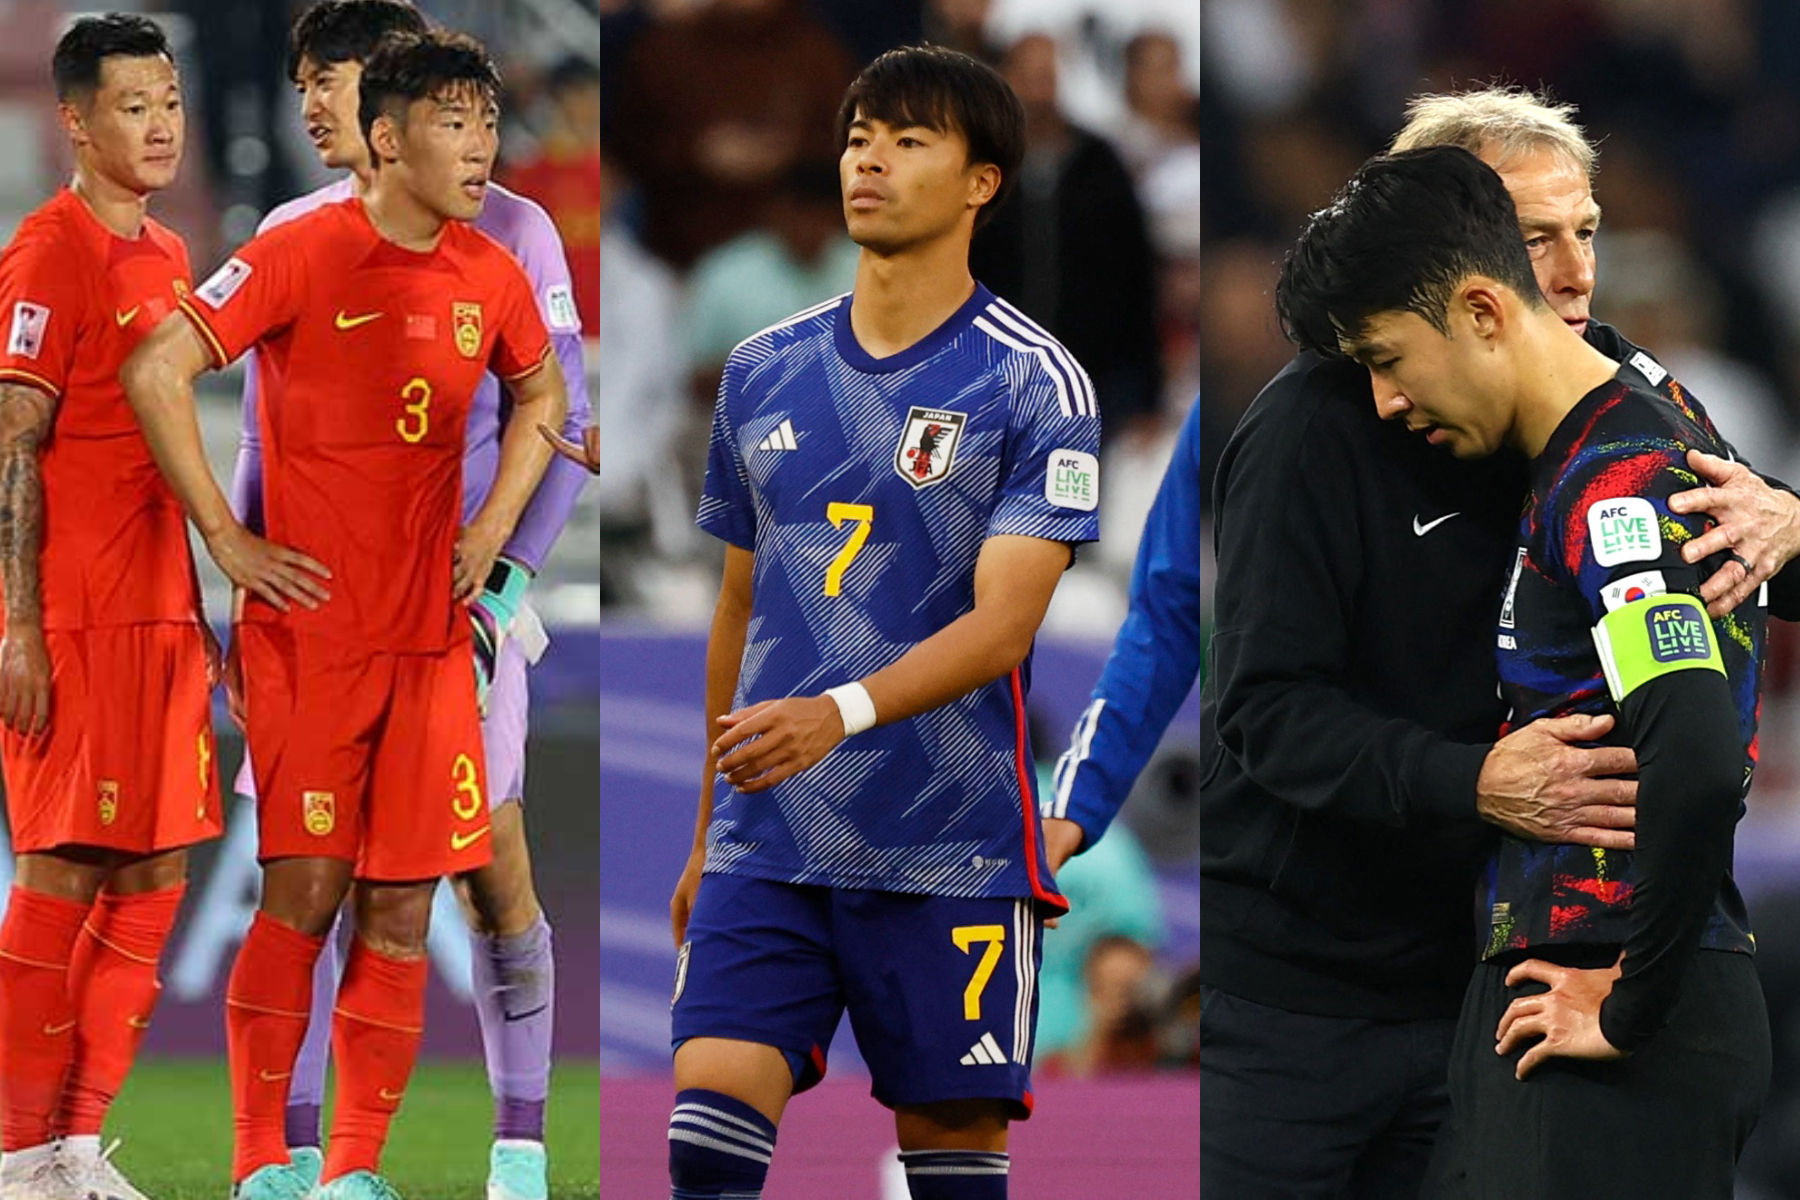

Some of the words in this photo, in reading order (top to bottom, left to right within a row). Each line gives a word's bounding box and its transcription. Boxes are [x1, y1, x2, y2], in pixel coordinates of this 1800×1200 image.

[397, 378, 431, 443] 3
[923, 411, 953, 422] JAPAN
[1057, 458, 1079, 470] AFC
[1056, 468, 1091, 487] LIVE
[1600, 506, 1628, 520] AFC
[1601, 517, 1649, 537] LIVE
[823, 501, 874, 598] 7
[1653, 609, 1682, 623] AFC
[1654, 620, 1703, 640] LIVE
[452, 753, 482, 820] 3
[951, 924, 1005, 1020] 7
